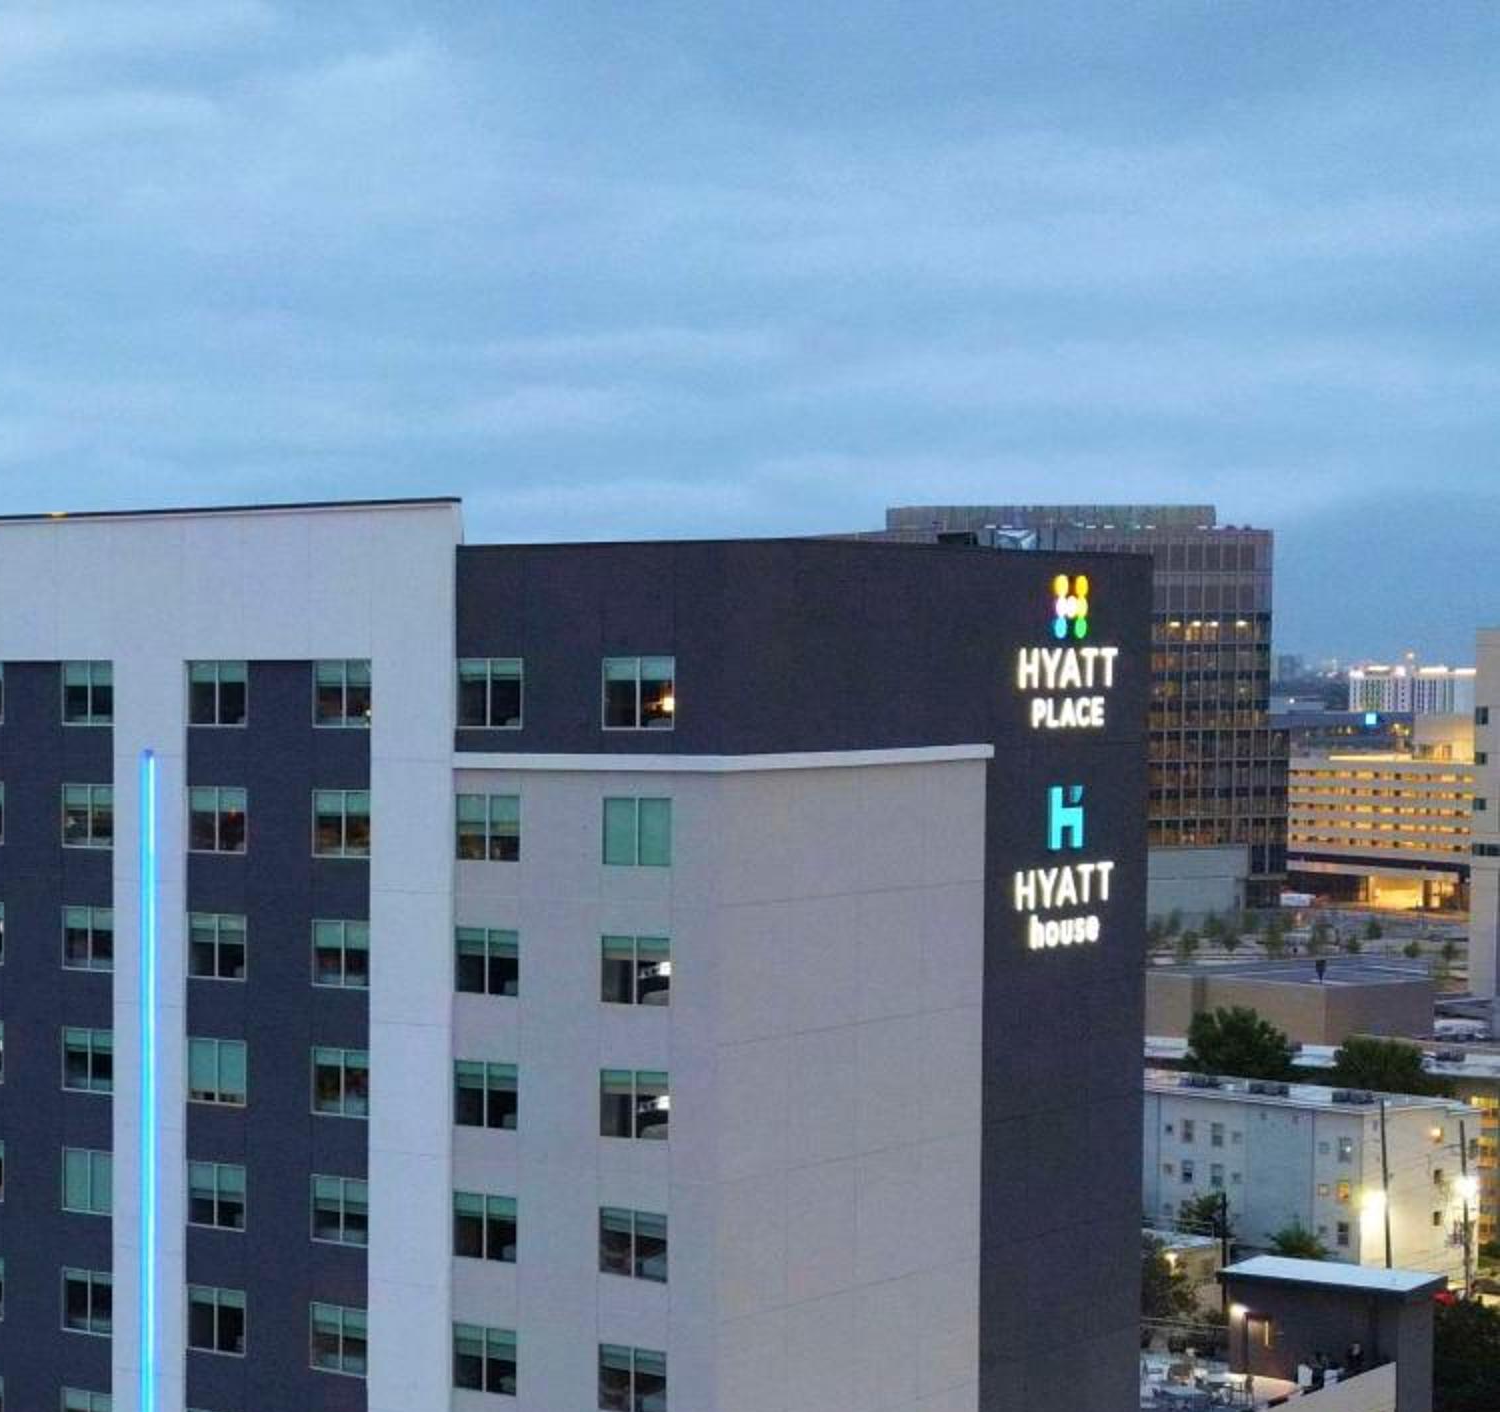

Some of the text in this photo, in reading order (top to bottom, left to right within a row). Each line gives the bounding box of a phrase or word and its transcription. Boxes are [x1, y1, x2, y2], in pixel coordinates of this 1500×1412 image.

[1018, 647, 1119, 689] HYATT
[1032, 696, 1105, 728] PLACE
[1014, 861, 1115, 911] HYATT
[1028, 914, 1100, 950] house
